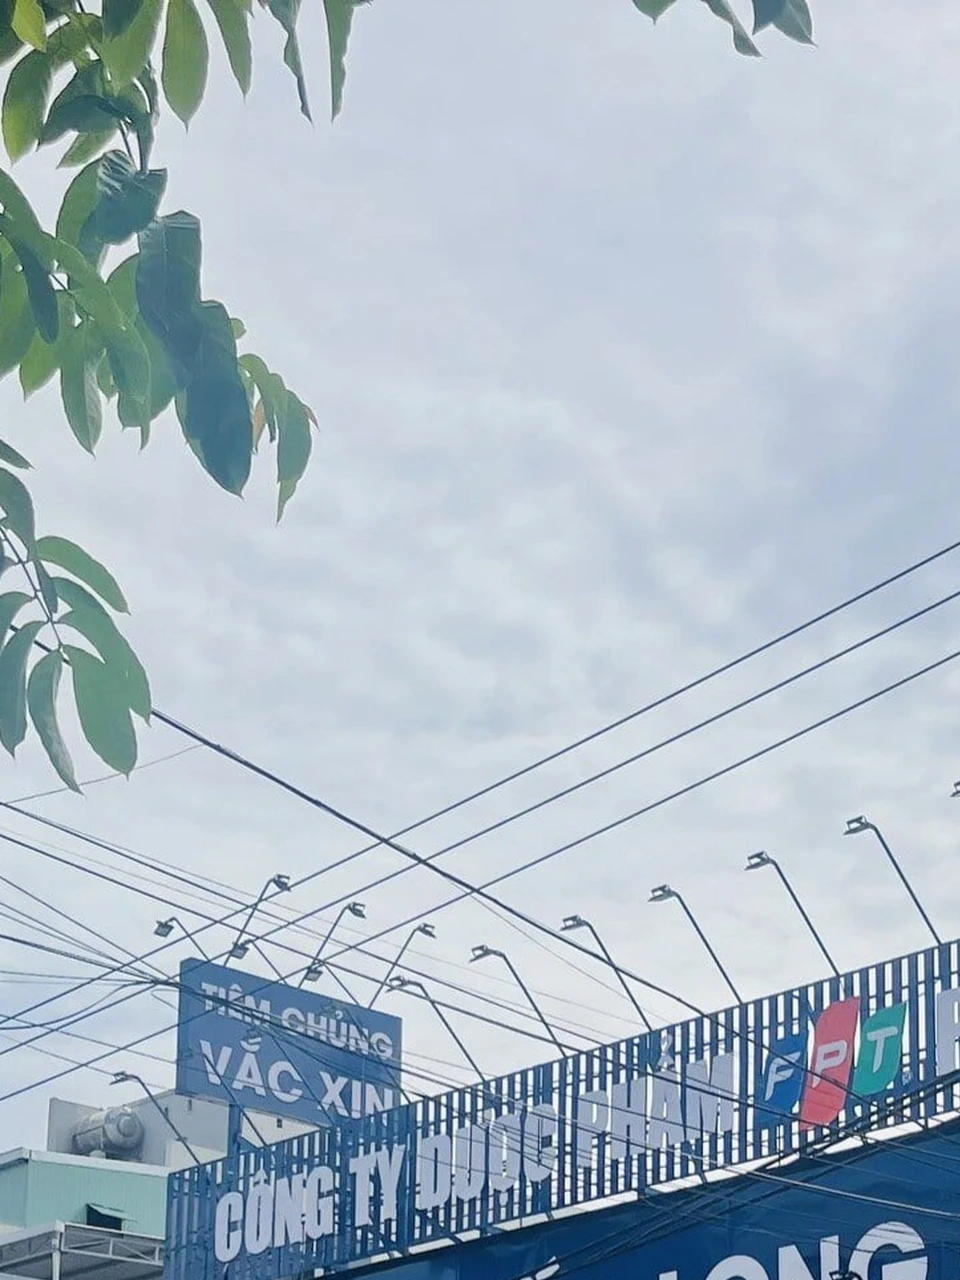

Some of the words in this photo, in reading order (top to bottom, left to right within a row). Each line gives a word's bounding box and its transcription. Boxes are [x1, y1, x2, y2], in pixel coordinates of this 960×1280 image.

[200, 982, 271, 1030] TIÊM
[281, 1007, 394, 1060] CHỦNG
[317, 1071, 393, 1121] XIN
[214, 1165, 335, 1262] CÔNG
[350, 1144, 405, 1227] TY
[577, 1034, 736, 1168] PHẨM
[762, 1018, 900, 1105] FPT
